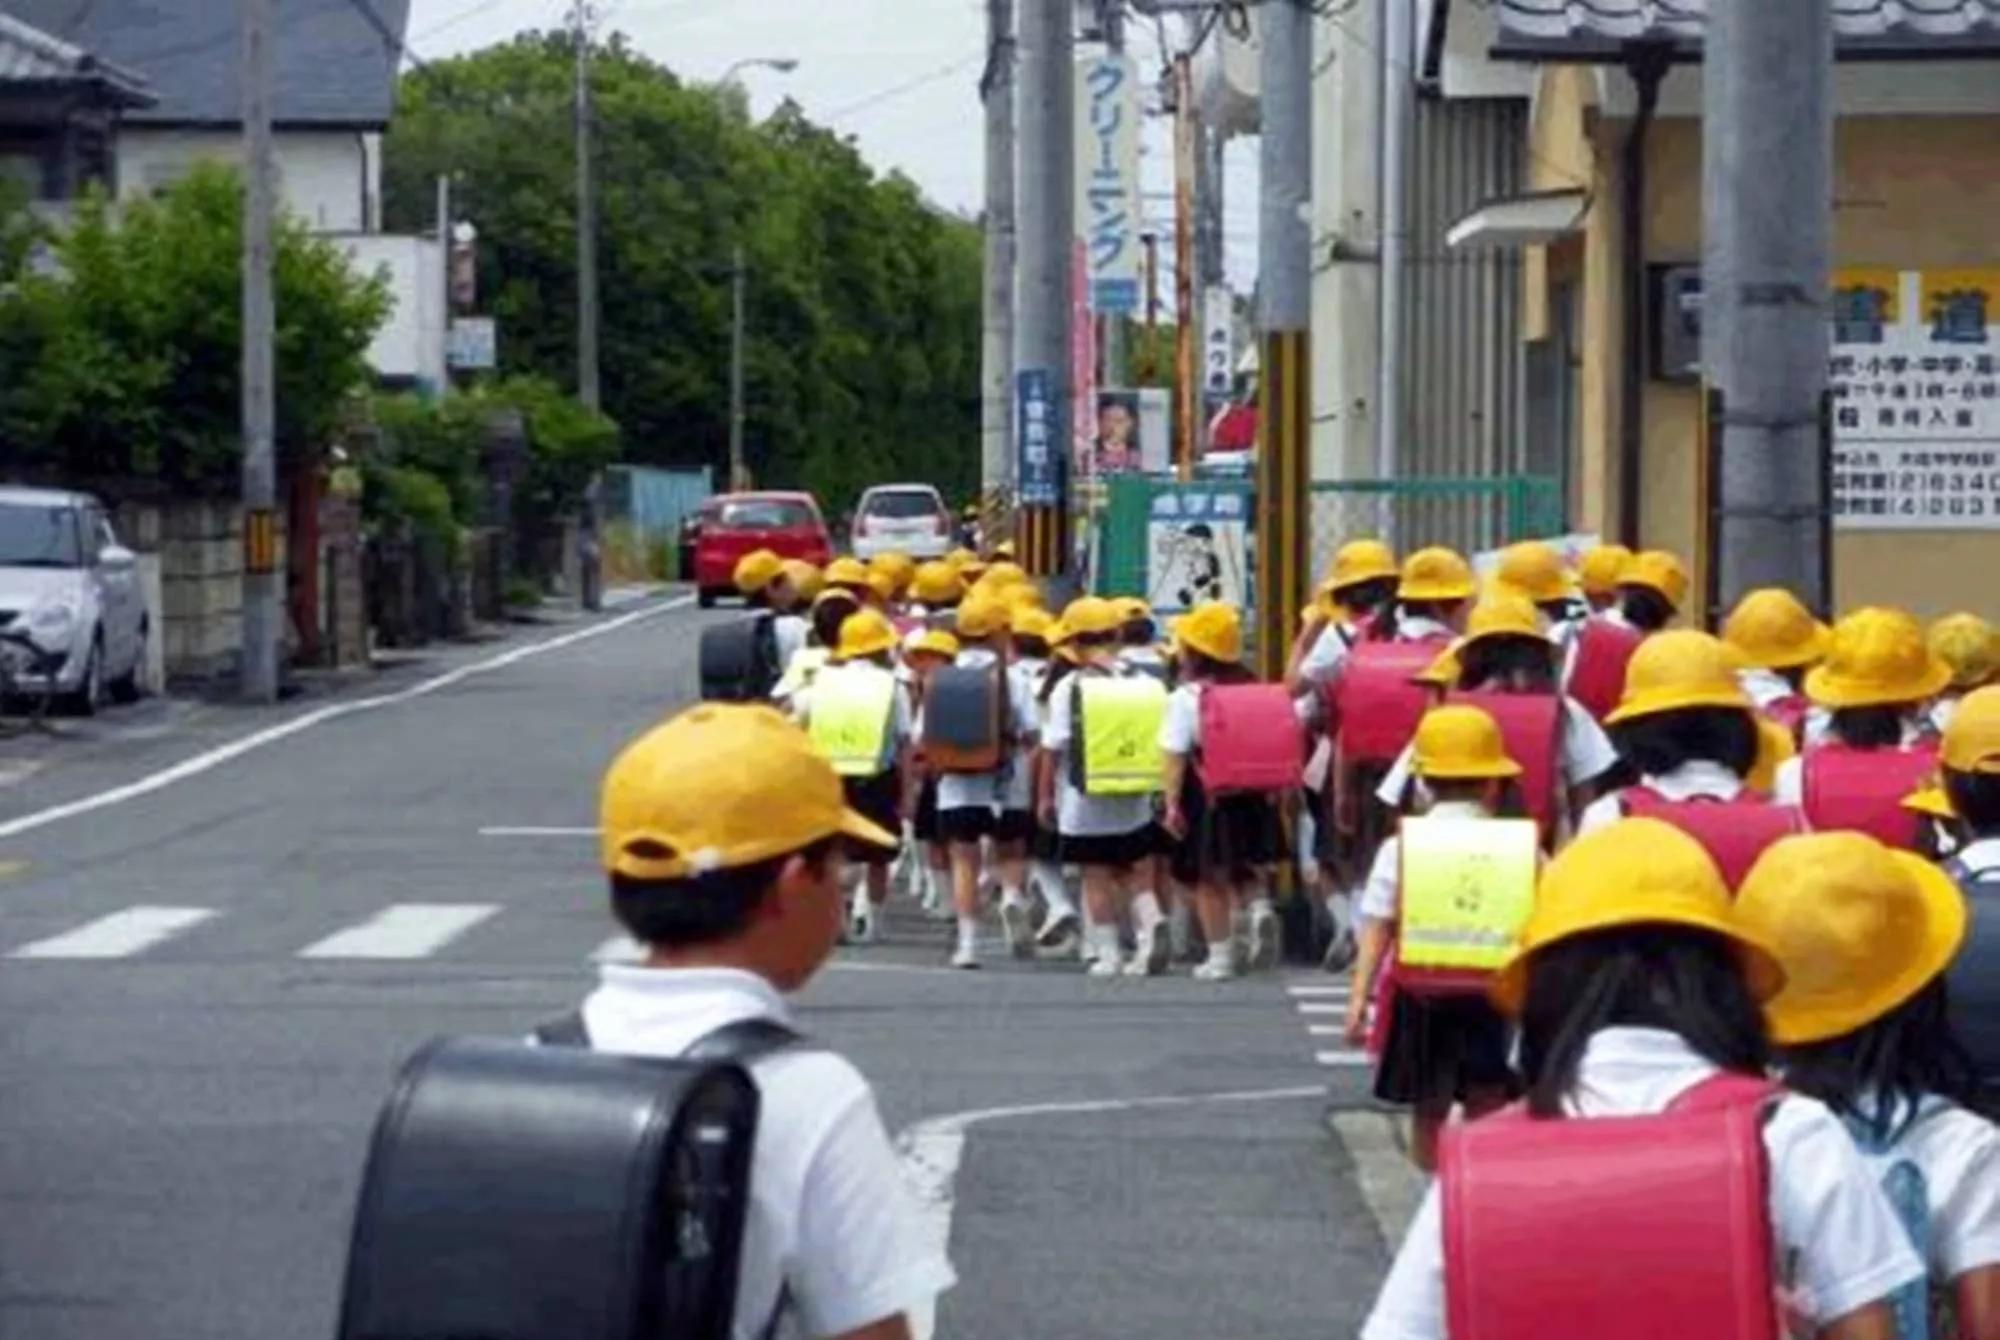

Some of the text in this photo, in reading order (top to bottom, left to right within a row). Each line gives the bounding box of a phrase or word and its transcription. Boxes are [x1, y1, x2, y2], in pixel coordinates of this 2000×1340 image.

[1087, 64, 1130, 270] クリーニング
